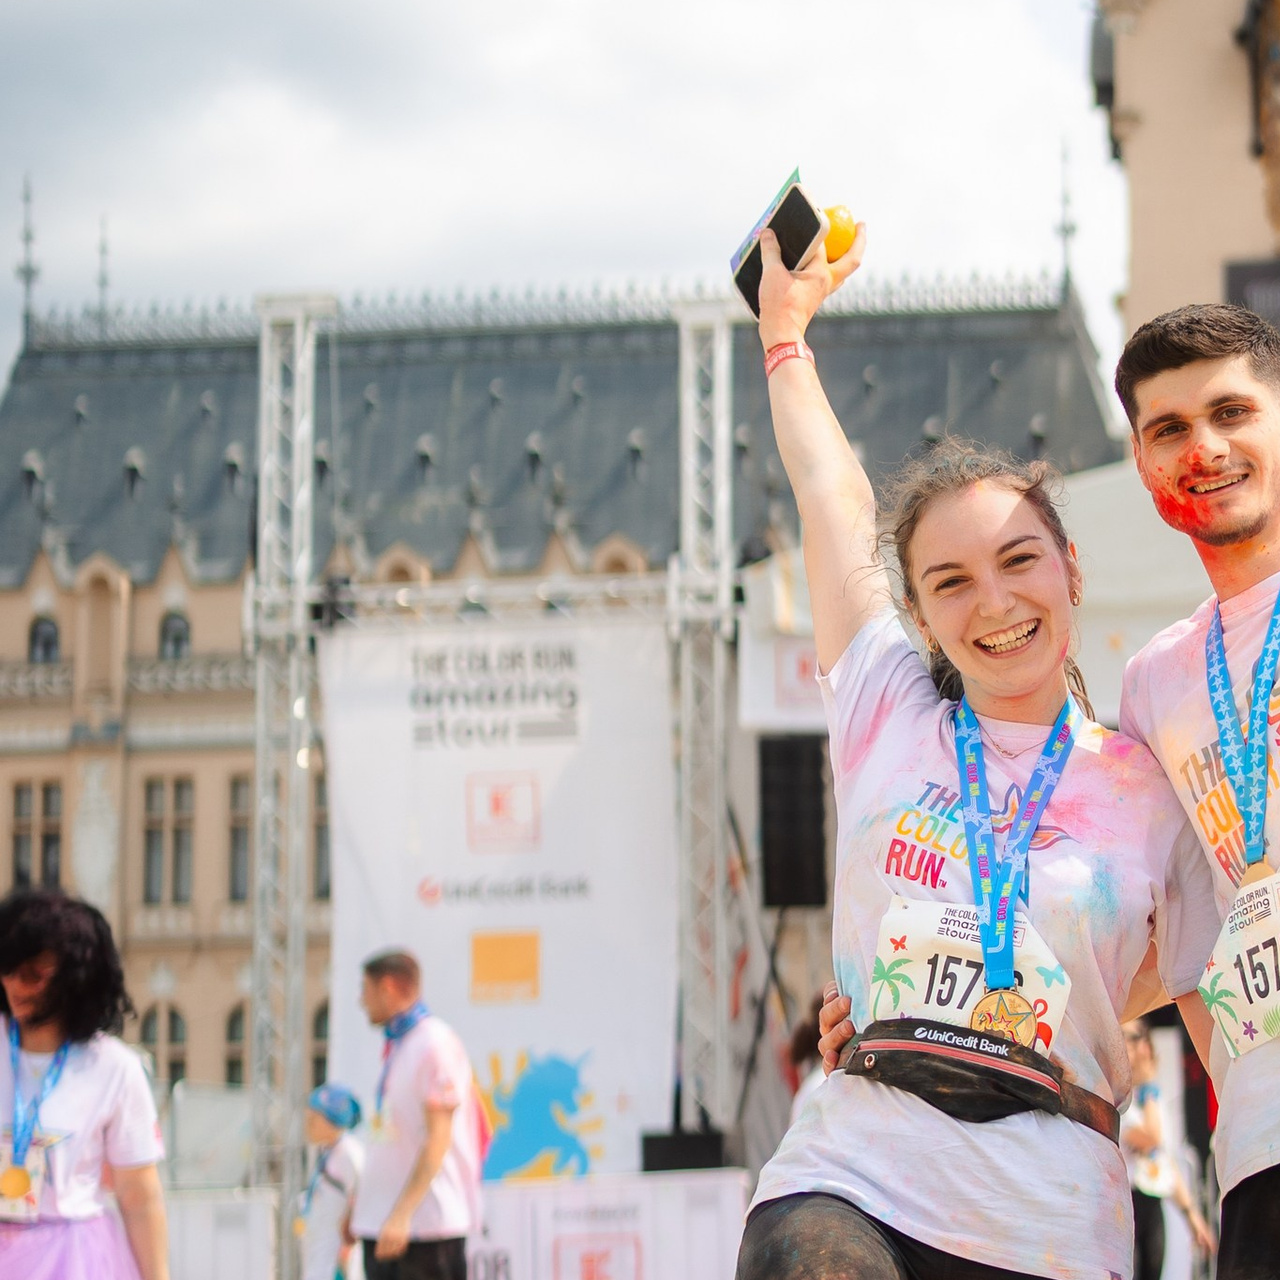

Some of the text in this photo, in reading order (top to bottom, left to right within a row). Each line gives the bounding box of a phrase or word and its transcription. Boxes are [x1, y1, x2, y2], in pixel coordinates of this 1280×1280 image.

[409, 680, 577, 717] amazing
[896, 810, 970, 866] COLO
[885, 838, 946, 889] RUN
[944, 907, 981, 921] THE COLO
[997, 896, 1010, 921] COLOR
[1228, 898, 1271, 924] amazing
[940, 917, 981, 933] amazi
[945, 926, 971, 941] tour
[1233, 916, 1255, 932] tour
[924, 953, 1023, 1010] 157
[927, 1029, 1010, 1057] UniCredit Bank
